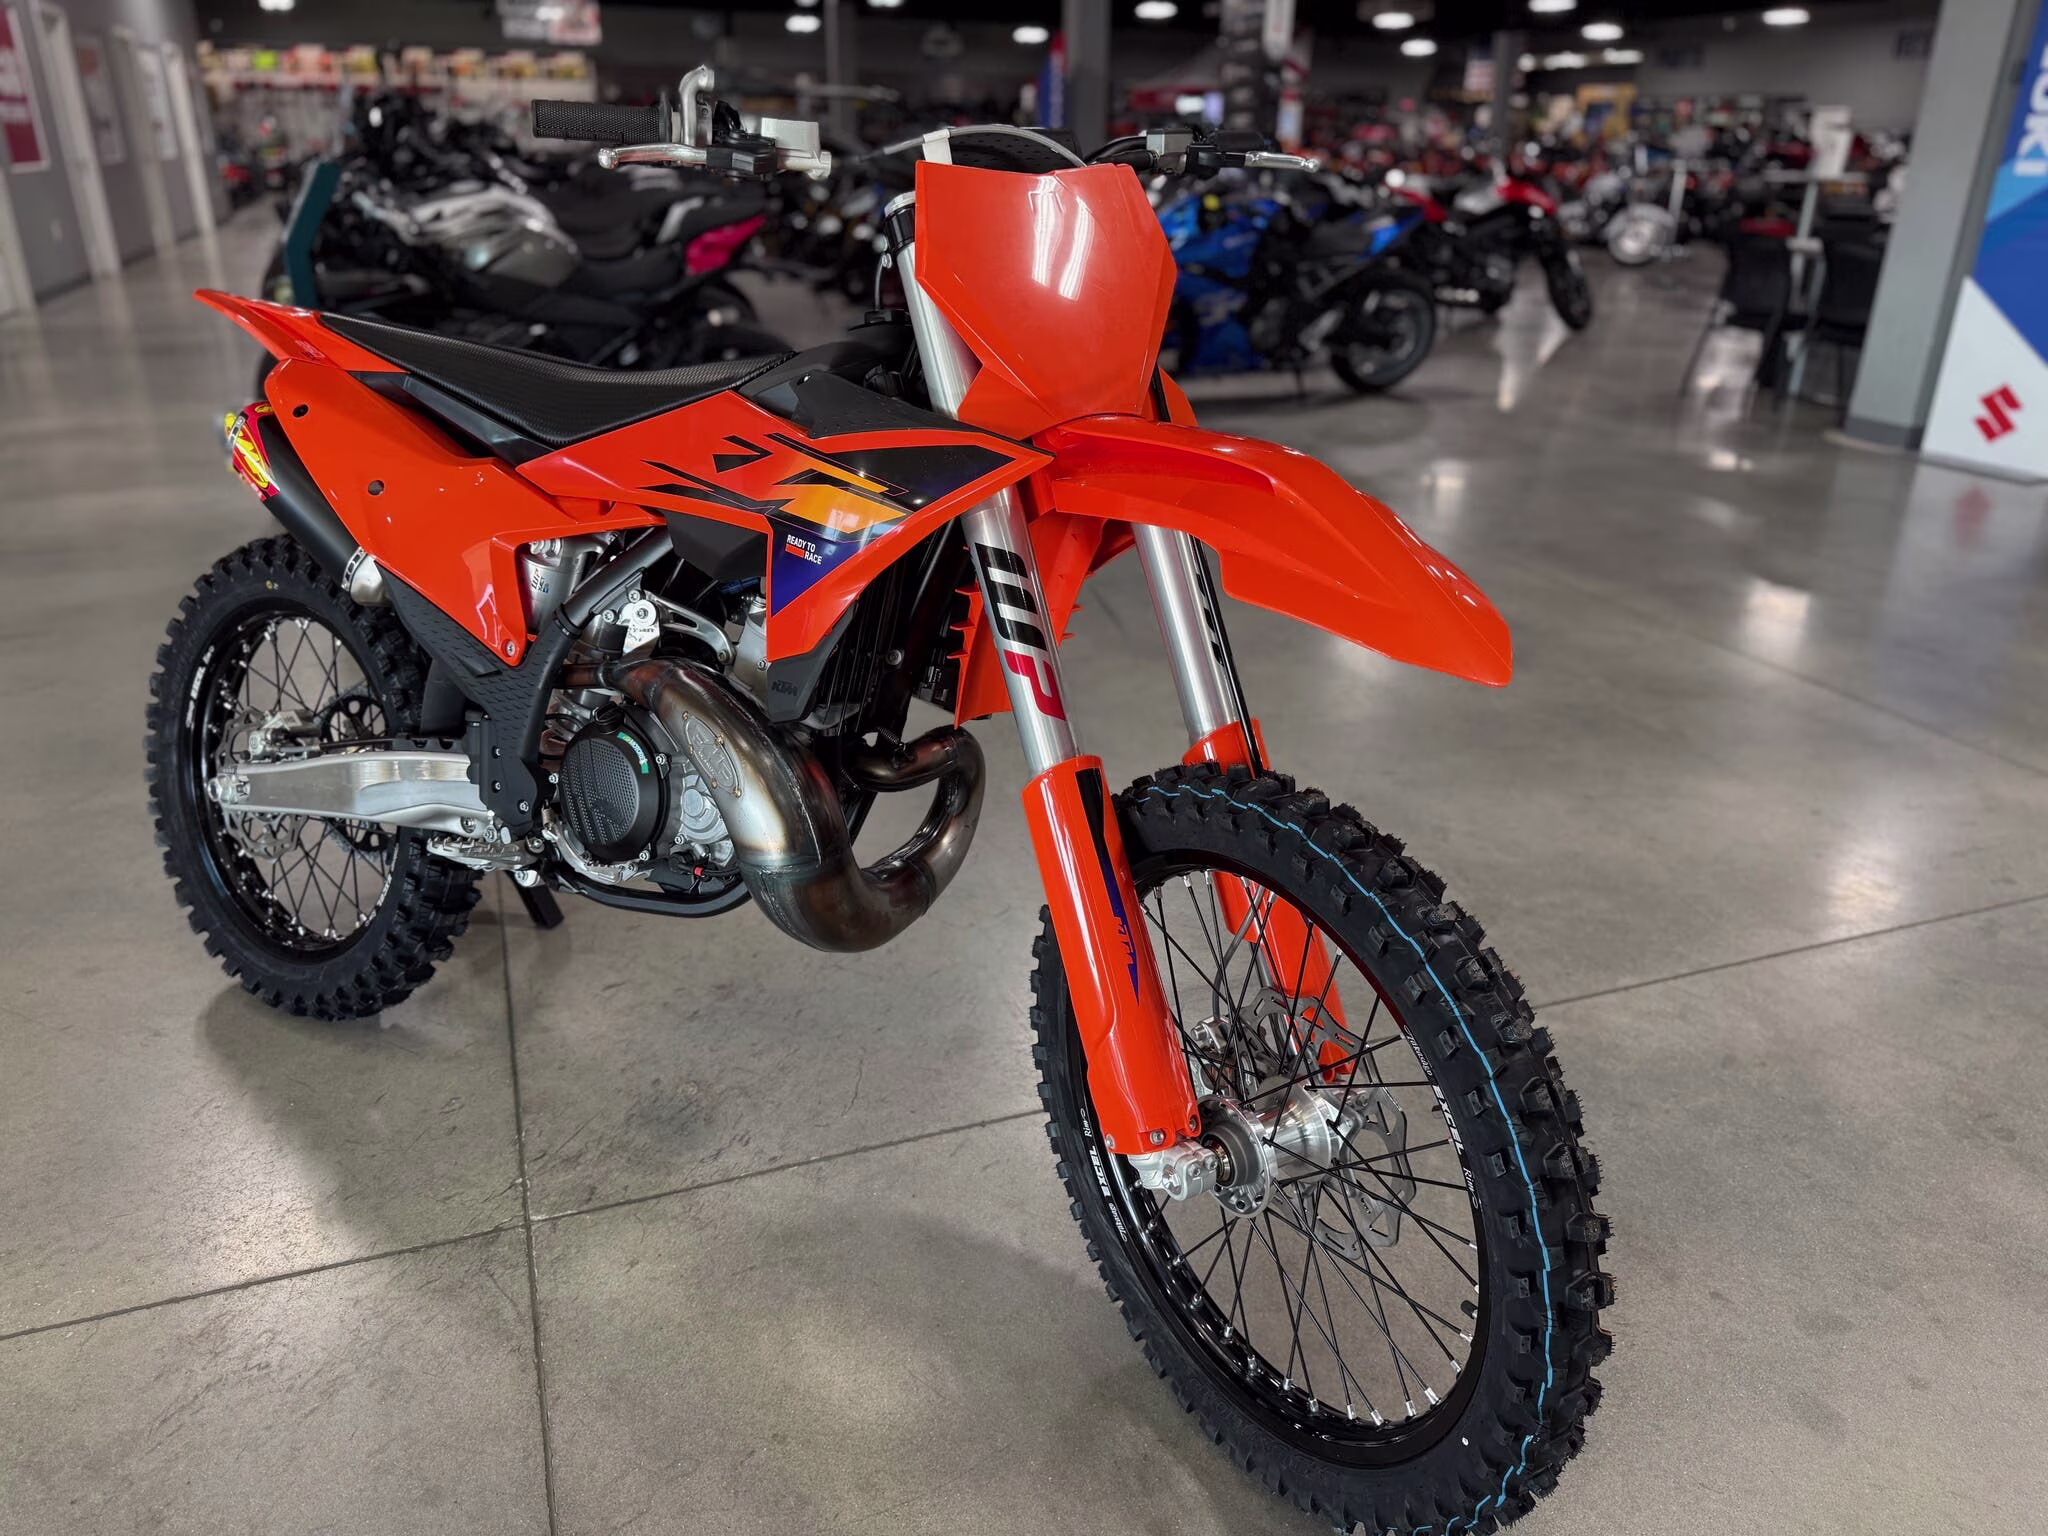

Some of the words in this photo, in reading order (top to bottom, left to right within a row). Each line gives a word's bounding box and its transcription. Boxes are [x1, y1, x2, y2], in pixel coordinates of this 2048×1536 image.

[2014, 41, 2048, 178] UKI
[786, 534, 807, 549] READY
[807, 541, 816, 553] TO
[804, 550, 823, 565] RACE
[975, 542, 1066, 721] WP
[1432, 1084, 1465, 1156] EXCEL
[1089, 1145, 1111, 1197] EXCEL
